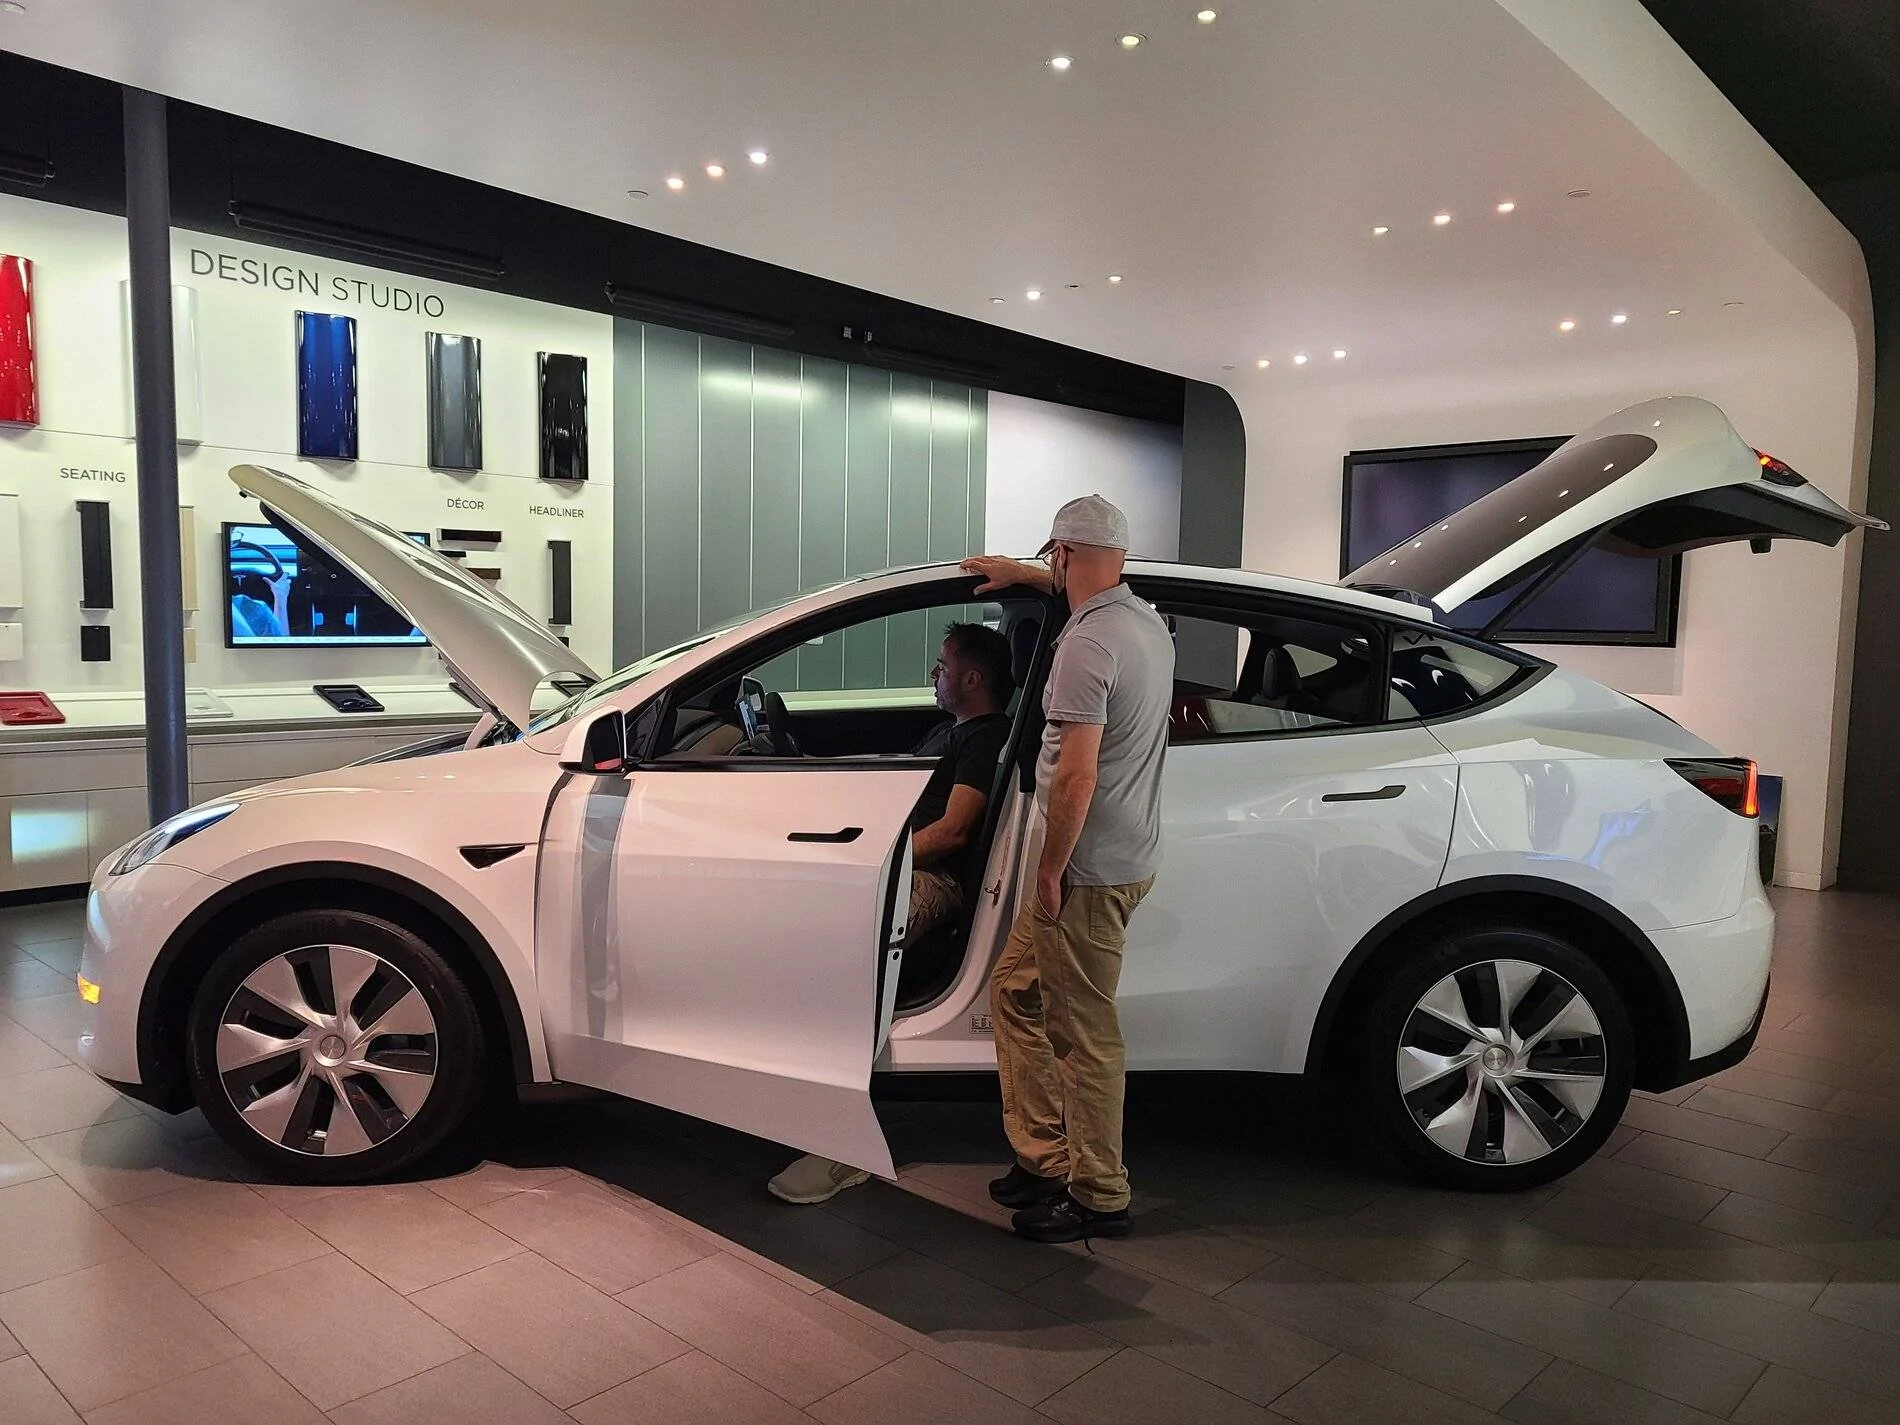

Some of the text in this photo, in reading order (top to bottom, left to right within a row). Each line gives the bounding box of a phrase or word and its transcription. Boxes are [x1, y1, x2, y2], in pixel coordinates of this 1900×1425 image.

[191, 249, 444, 318] DESIGN STUDIO
[60, 467, 126, 483] SEATING
[447, 497, 485, 510] DÉCOR
[529, 505, 584, 518] HEADLINER
